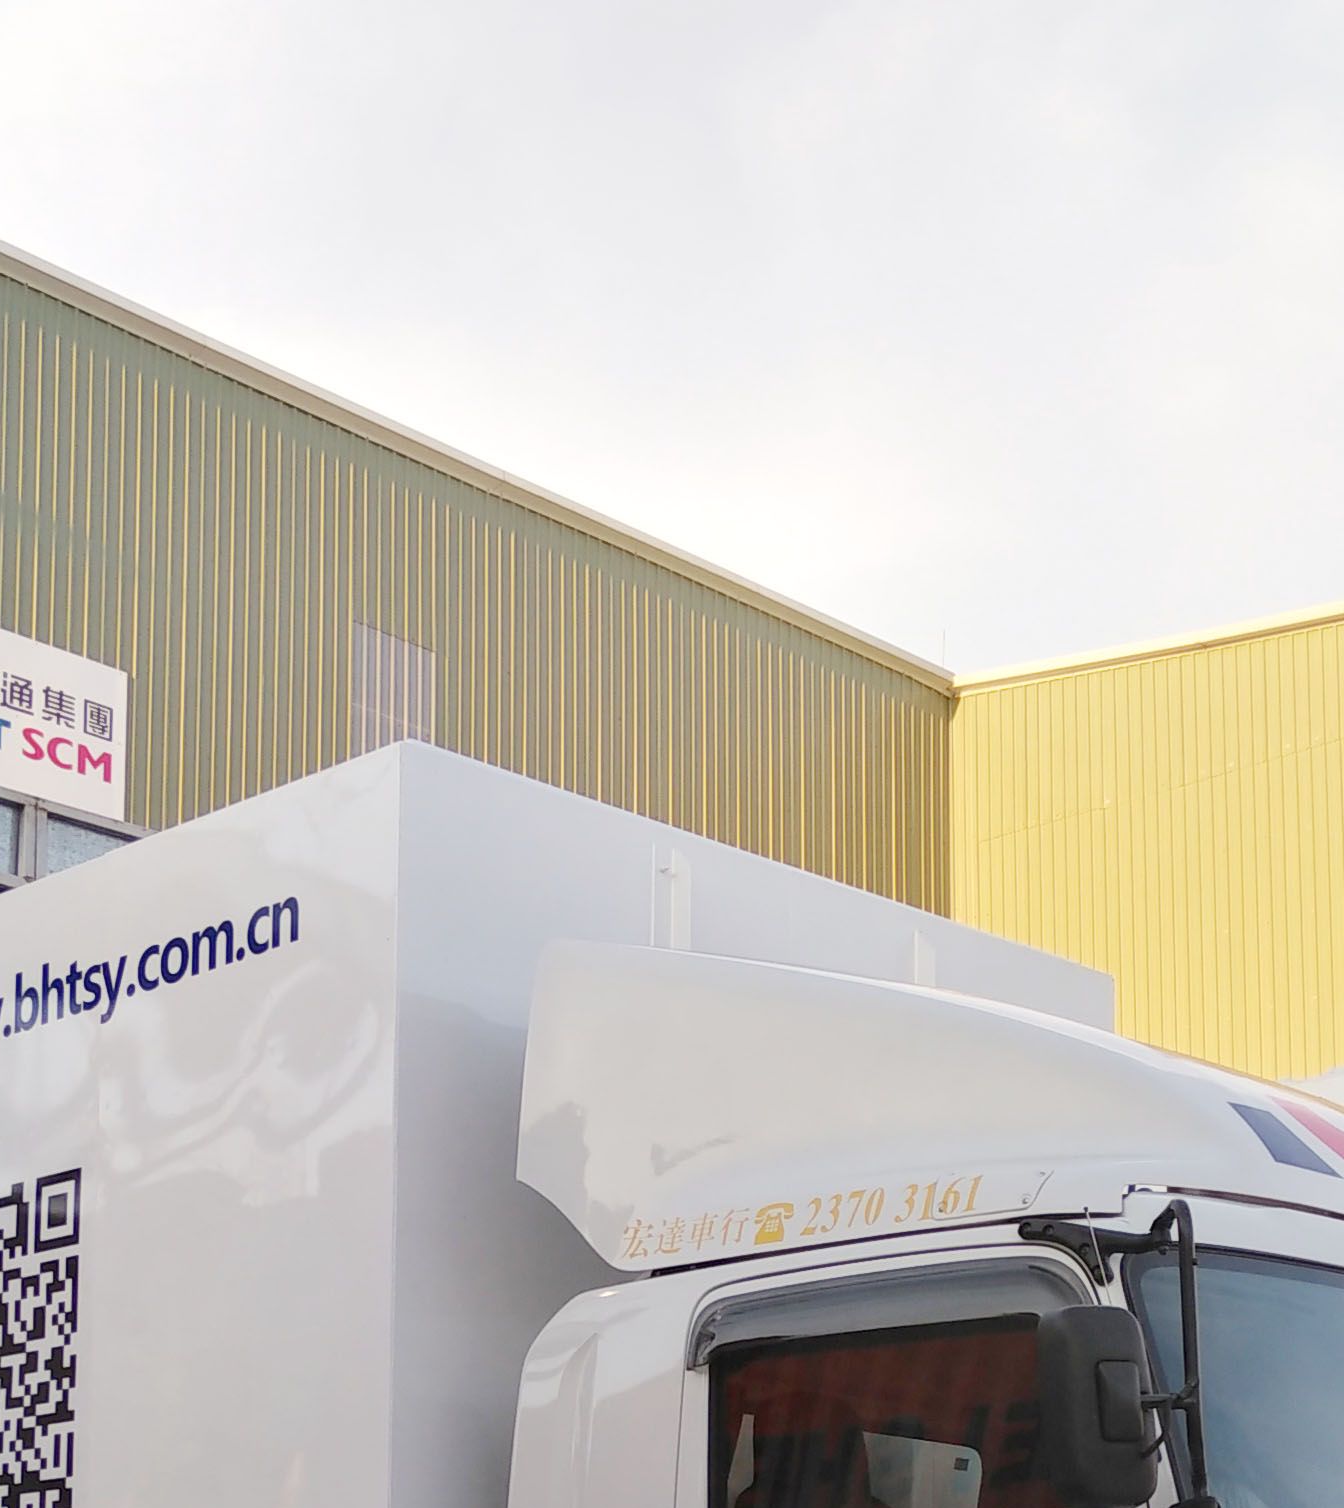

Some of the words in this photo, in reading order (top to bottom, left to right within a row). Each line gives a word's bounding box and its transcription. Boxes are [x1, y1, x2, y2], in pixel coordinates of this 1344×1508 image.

[22, 727, 113, 783] SCM
[622, 1207, 751, 1260] 宏達車行
[798, 1187, 885, 1237] 2370
[894, 1174, 984, 1224] 3161
